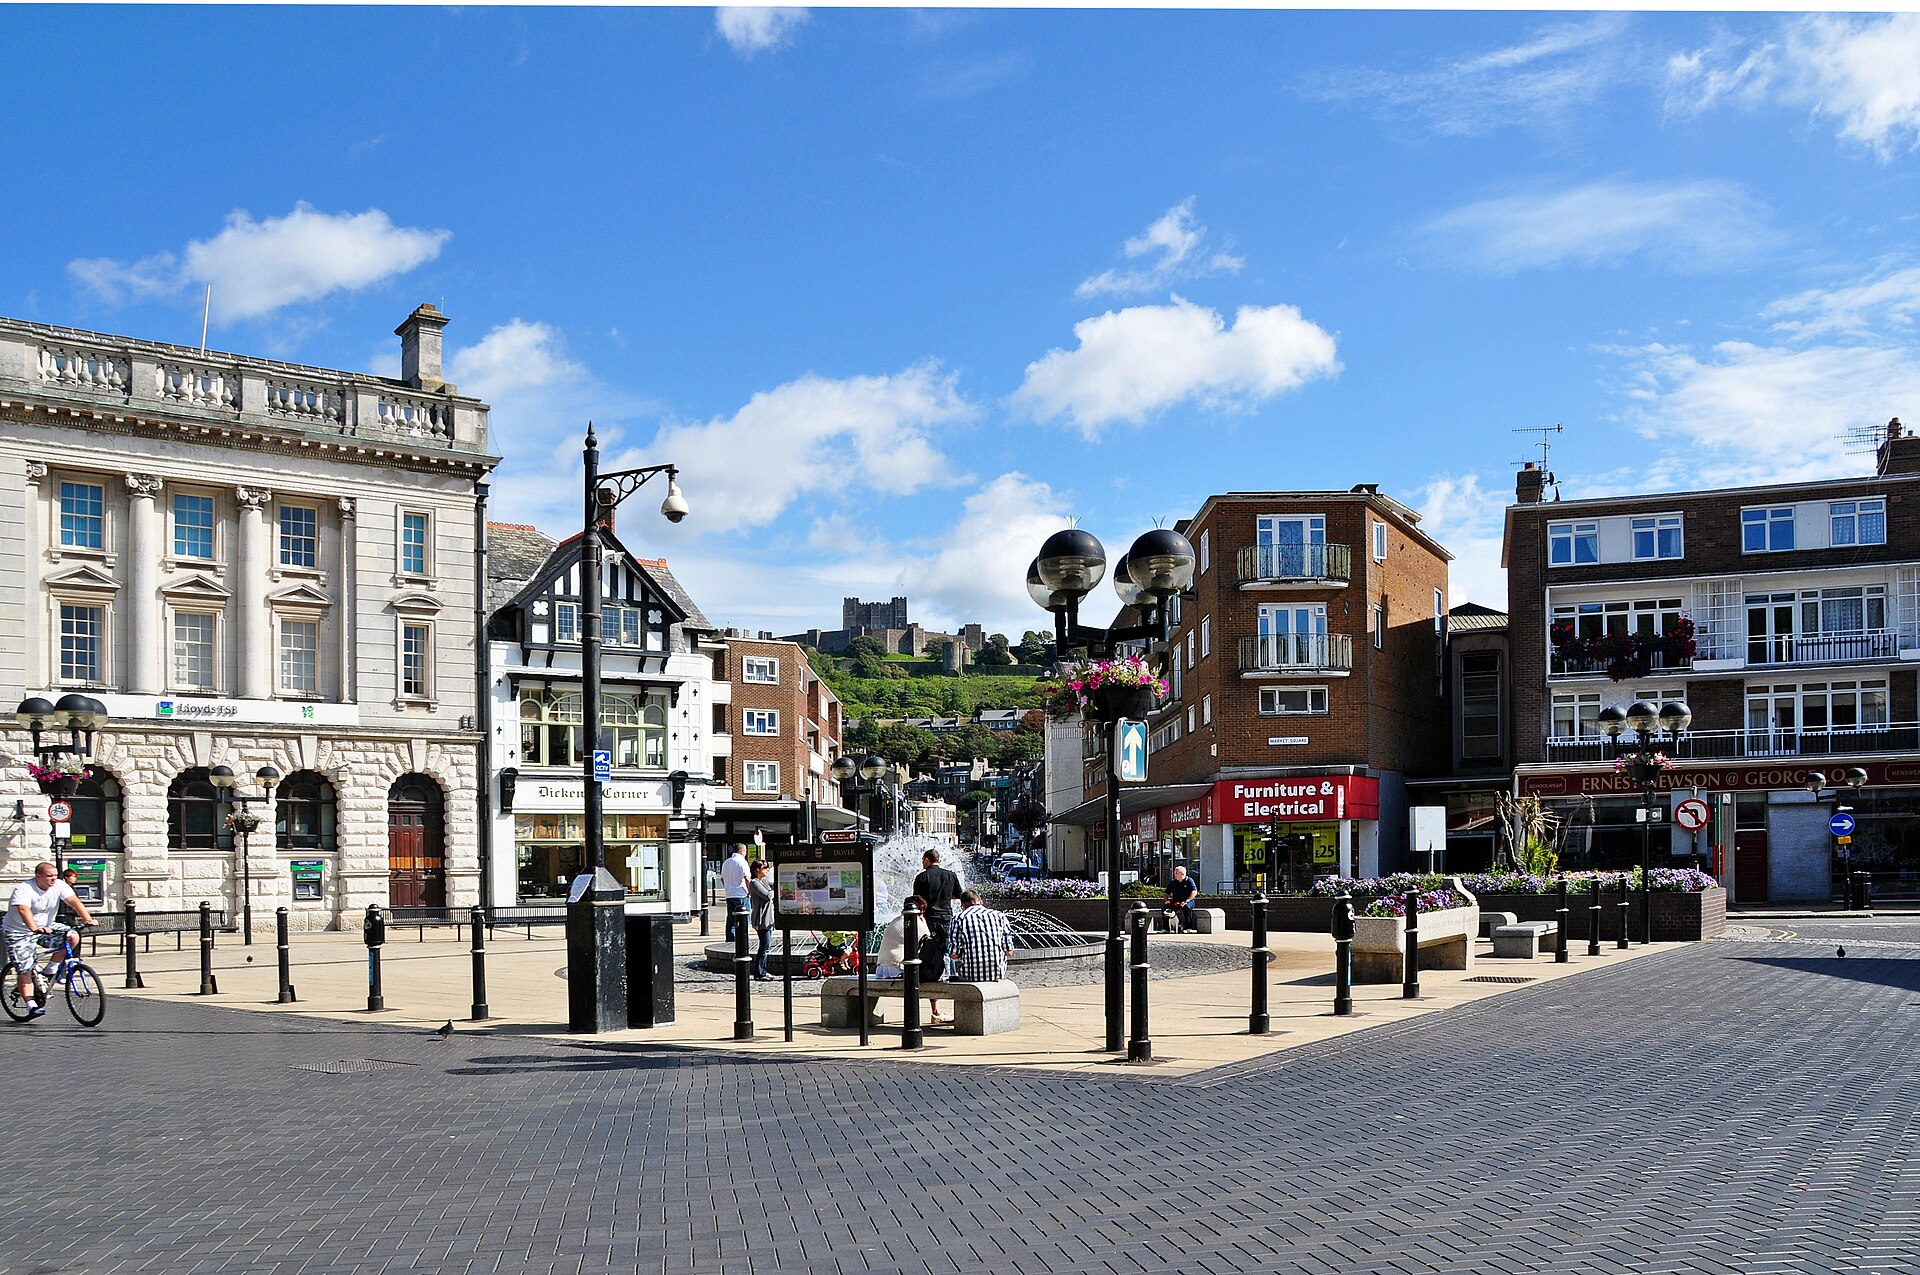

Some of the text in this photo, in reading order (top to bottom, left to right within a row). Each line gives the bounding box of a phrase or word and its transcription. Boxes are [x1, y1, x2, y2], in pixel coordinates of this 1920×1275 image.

[178, 703, 238, 717] Lloyds TSB
[1725, 771, 1739, 786] @
[1744, 769, 1816, 786] GEORG
[538, 786, 649, 799] Dicken Corner
[689, 790, 698, 799] 7
[1234, 781, 1334, 799] Furniture &
[1244, 799, 1324, 817] Electrical
[1245, 848, 1264, 860] £30
[1315, 845, 1335, 858] £25
